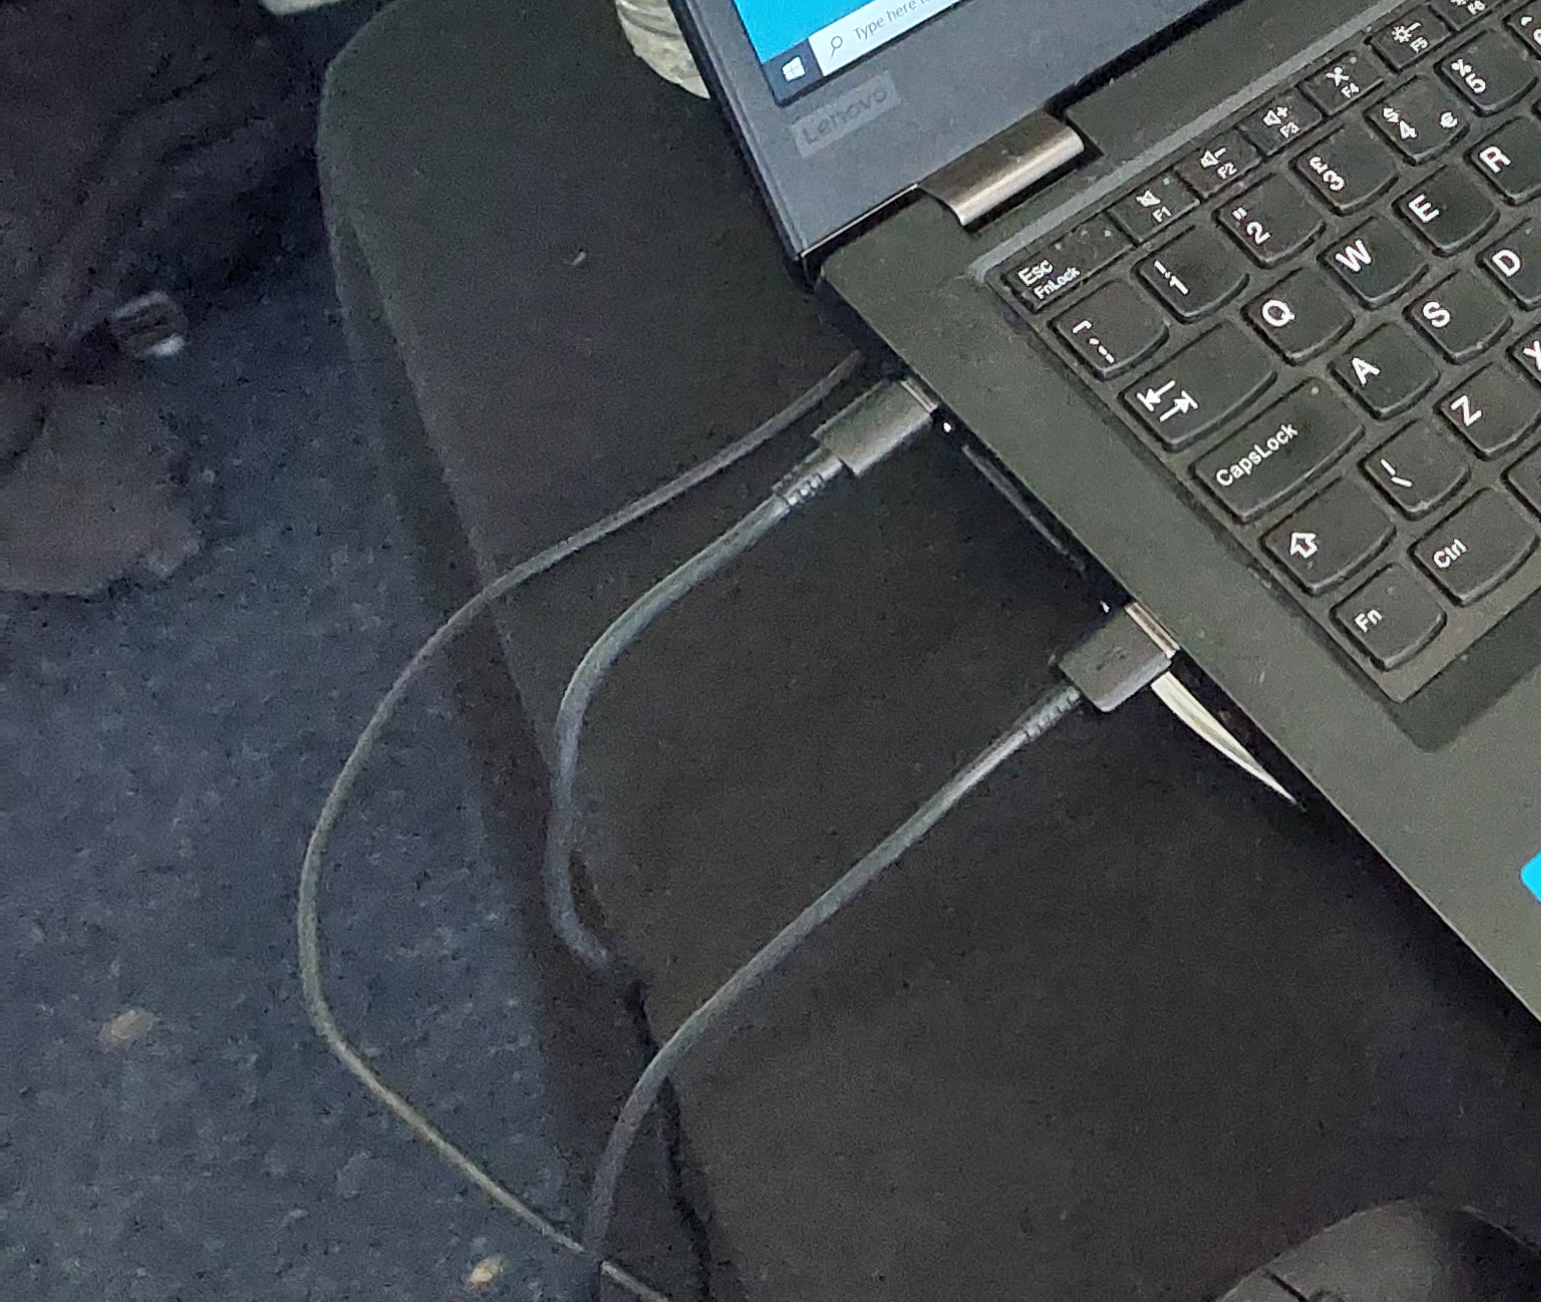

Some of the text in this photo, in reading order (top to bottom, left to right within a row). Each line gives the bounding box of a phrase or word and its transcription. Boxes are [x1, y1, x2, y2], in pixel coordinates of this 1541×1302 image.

[853, 17, 885, 40] Type
[885, 0, 917, 22] here
[801, 87, 888, 145] Lenovo
[1017, 258, 1054, 287] Esc
[1033, 267, 1081, 301] FnLock
[1215, 422, 1298, 489] CapsLock
[1433, 539, 1467, 569] Ctrl
[1354, 607, 1382, 633] Fn
